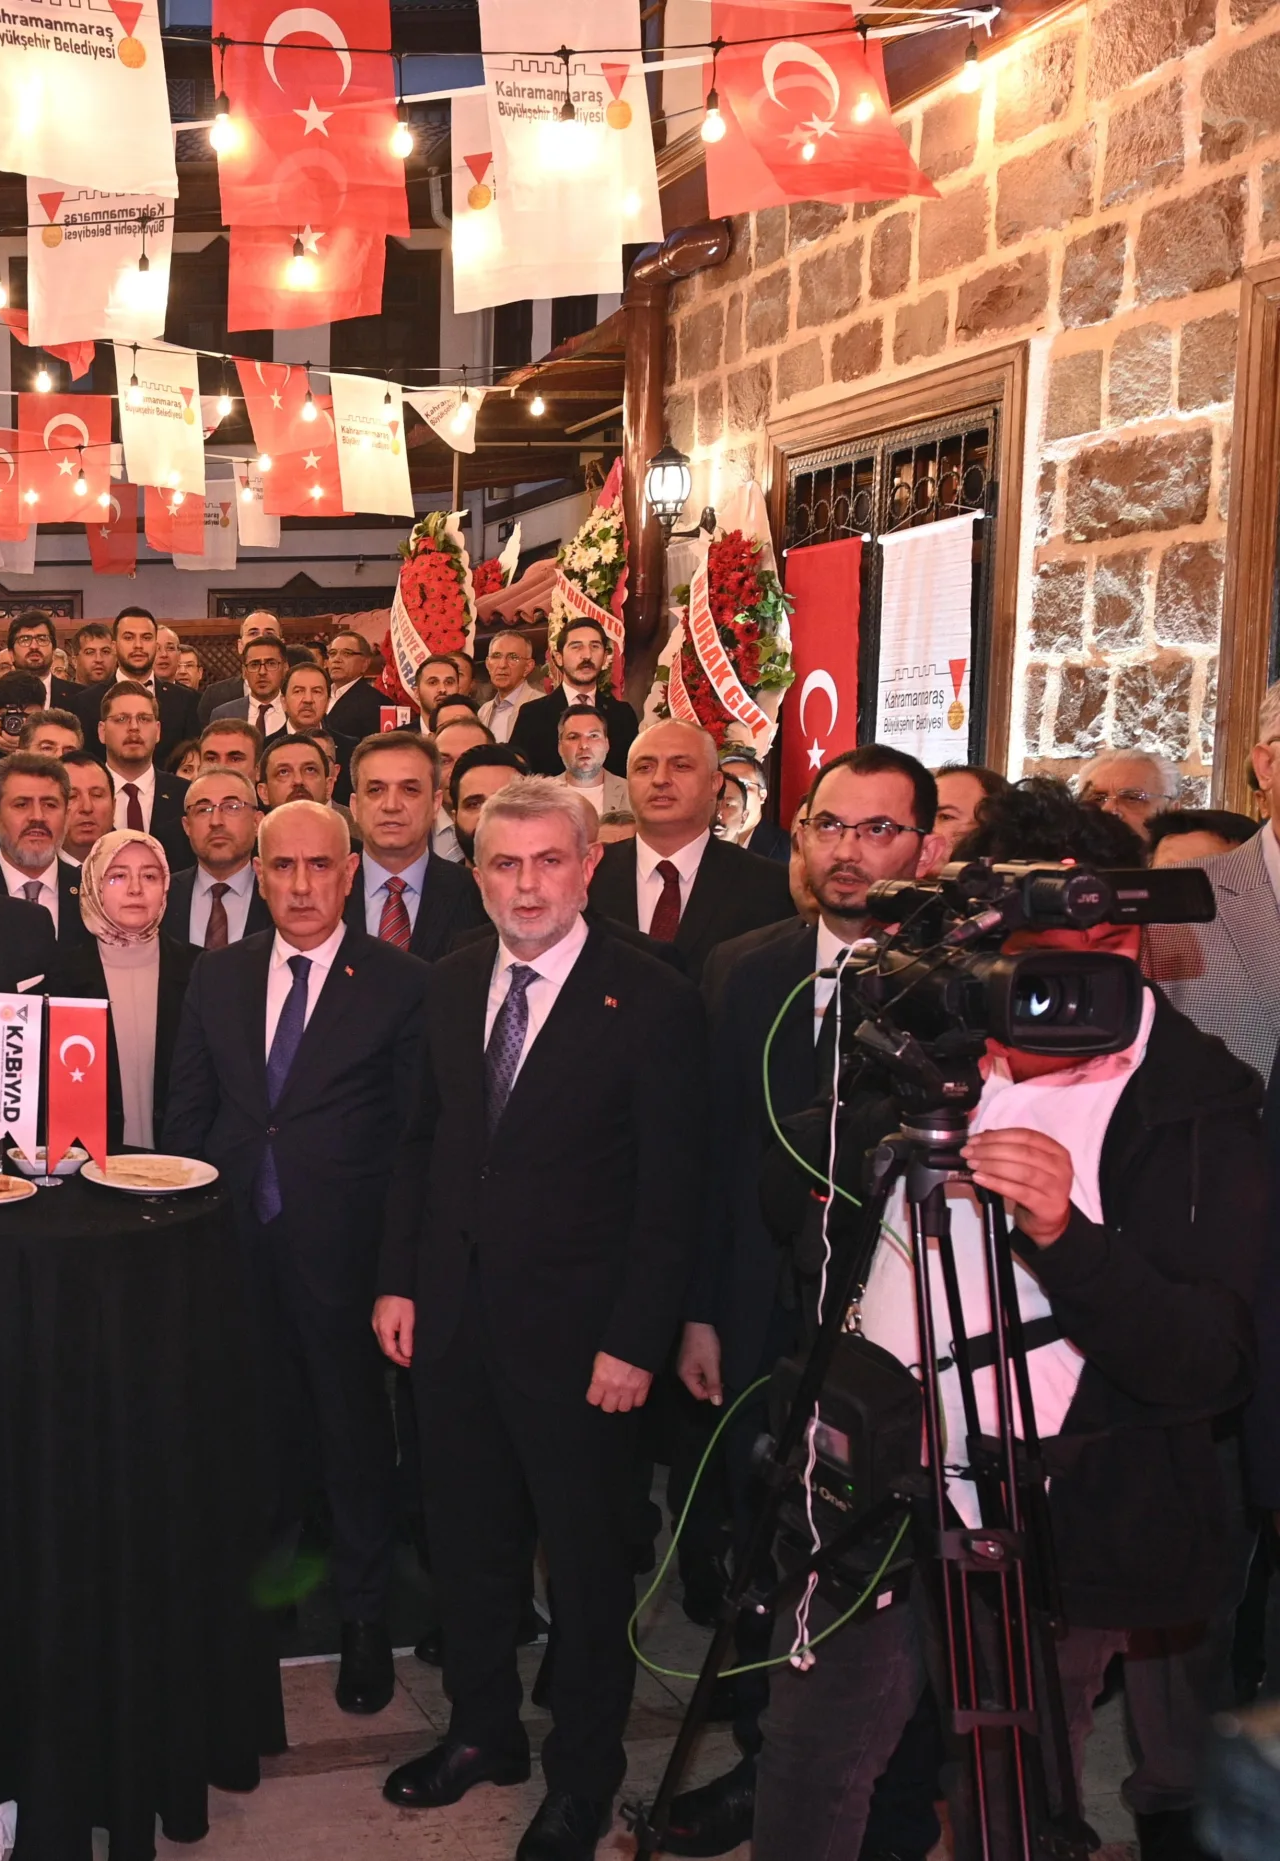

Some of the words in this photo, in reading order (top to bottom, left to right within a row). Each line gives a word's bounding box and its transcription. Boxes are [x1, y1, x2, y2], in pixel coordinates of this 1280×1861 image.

[53, 36, 116, 60] Belediyesi
[723, 685, 770, 739] GÜL
[1077, 893, 1099, 904] JVC
